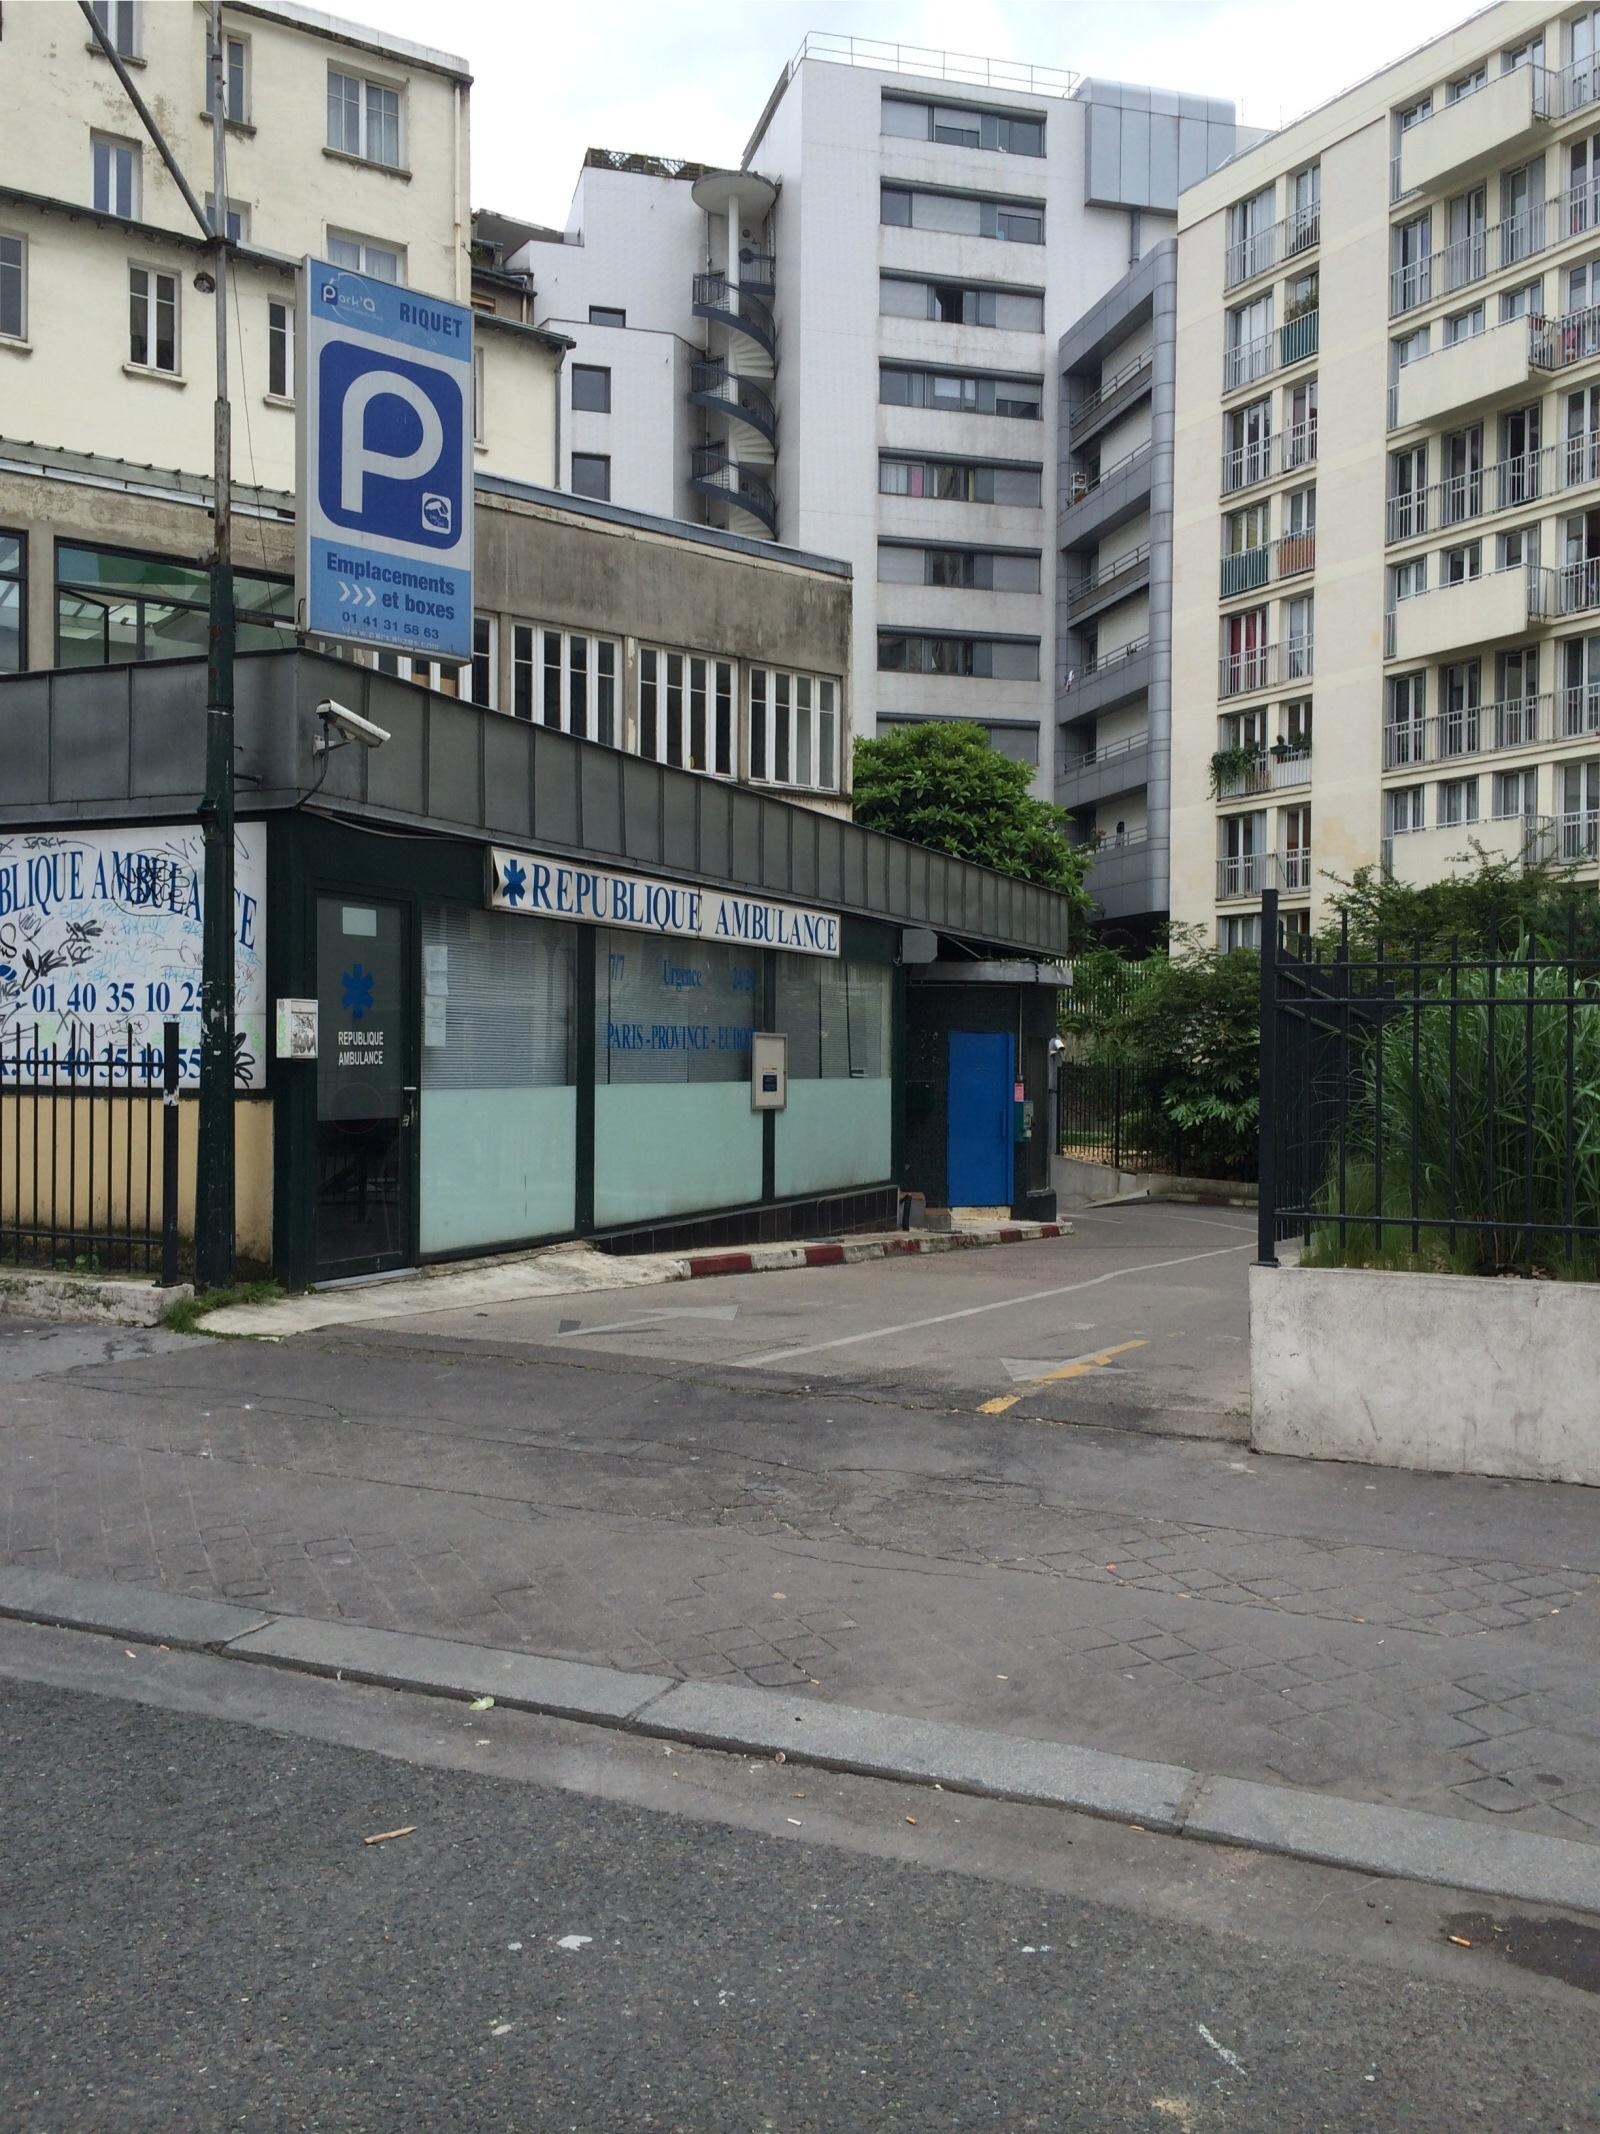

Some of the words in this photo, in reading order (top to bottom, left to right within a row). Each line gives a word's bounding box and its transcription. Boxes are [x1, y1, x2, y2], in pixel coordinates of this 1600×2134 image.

[400, 302, 463, 338] RIQUET
[341, 370, 444, 514] P
[327, 551, 456, 596] Emplacements
[382, 591, 399, 610] et
[405, 594, 456, 621] boxes
[342, 611, 357, 624] 01
[363, 615, 378, 628] 41
[384, 619, 398, 632] 31
[404, 623, 419, 636] 58
[424, 627, 439, 640] 63
[531, 863, 703, 933] REPUBLIQUE
[715, 898, 837, 952] AMBULANCE
[32, 982, 56, 1013] 01
[67, 982, 97, 1013] 40
[106, 982, 136, 1013] 35
[145, 982, 171, 1013] 10
[338, 1031, 384, 1047] REPUBLIQUE
[26, 1047, 50, 1077] 01
[61, 1048, 90, 1078] 40
[100, 1048, 128, 1079] 35
[338, 1051, 384, 1067] AMBULANCE
